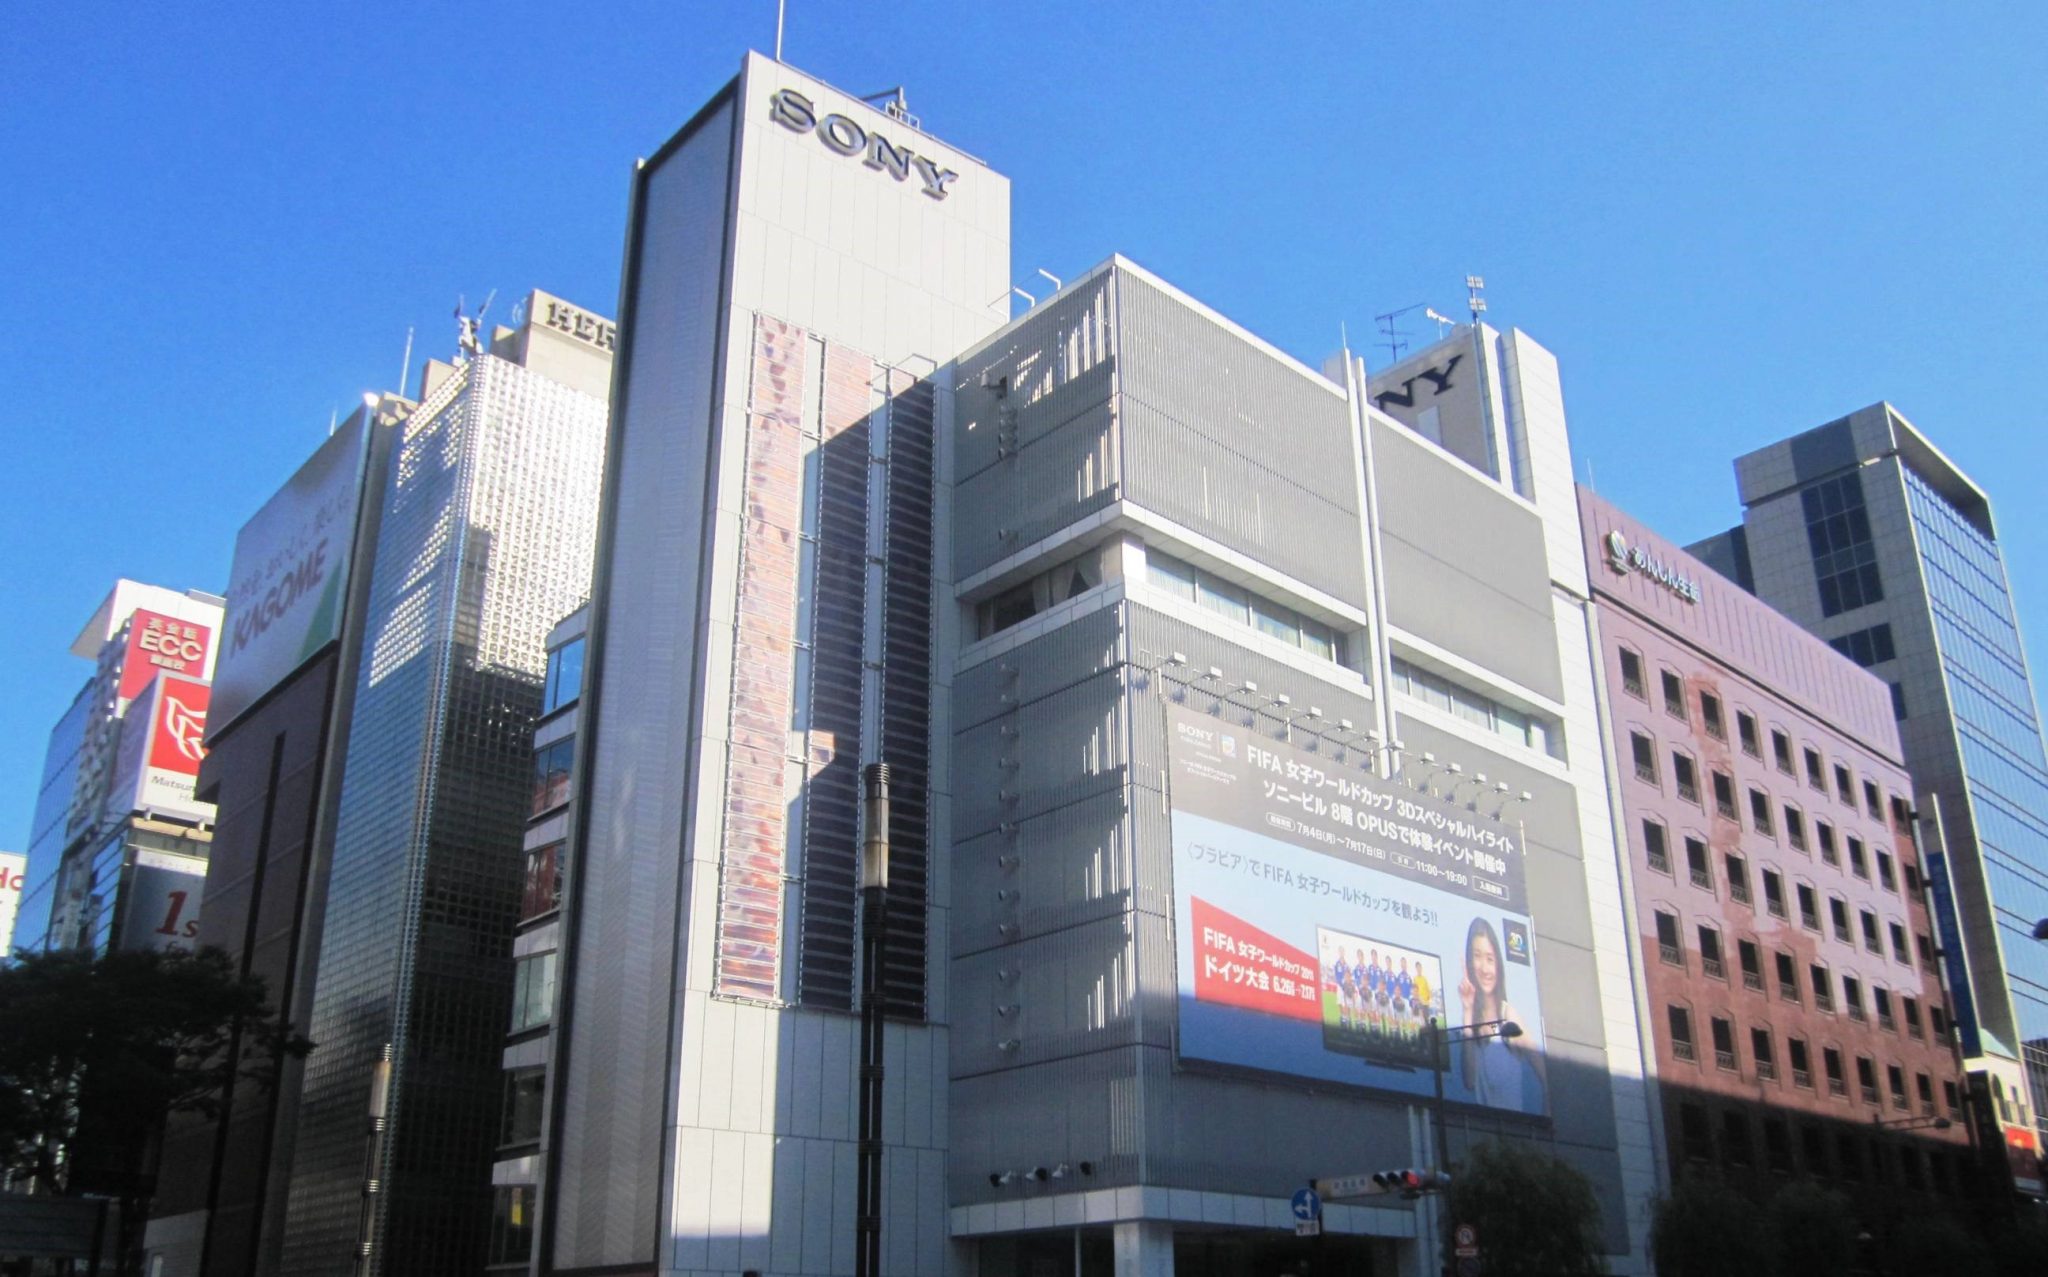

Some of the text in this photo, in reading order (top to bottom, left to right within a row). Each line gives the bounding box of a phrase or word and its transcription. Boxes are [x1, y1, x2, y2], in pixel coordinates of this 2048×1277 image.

[769, 88, 959, 201] SONY
[230, 537, 329, 659] KAGOME
[139, 628, 203, 663] ECC
[1247, 744, 1283, 775] FIFA
[1286, 759, 1393, 811] 女子ワールドカップ
[1397, 798, 1515, 855] 3Dスペシャルハイライト
[1263, 779, 1327, 816] ソニービル
[1331, 802, 1354, 827] 8階
[1263, 863, 1294, 887] FIFA
[1203, 926, 1236, 955] FIFA
[1205, 953, 1270, 992] ドイツ大会
